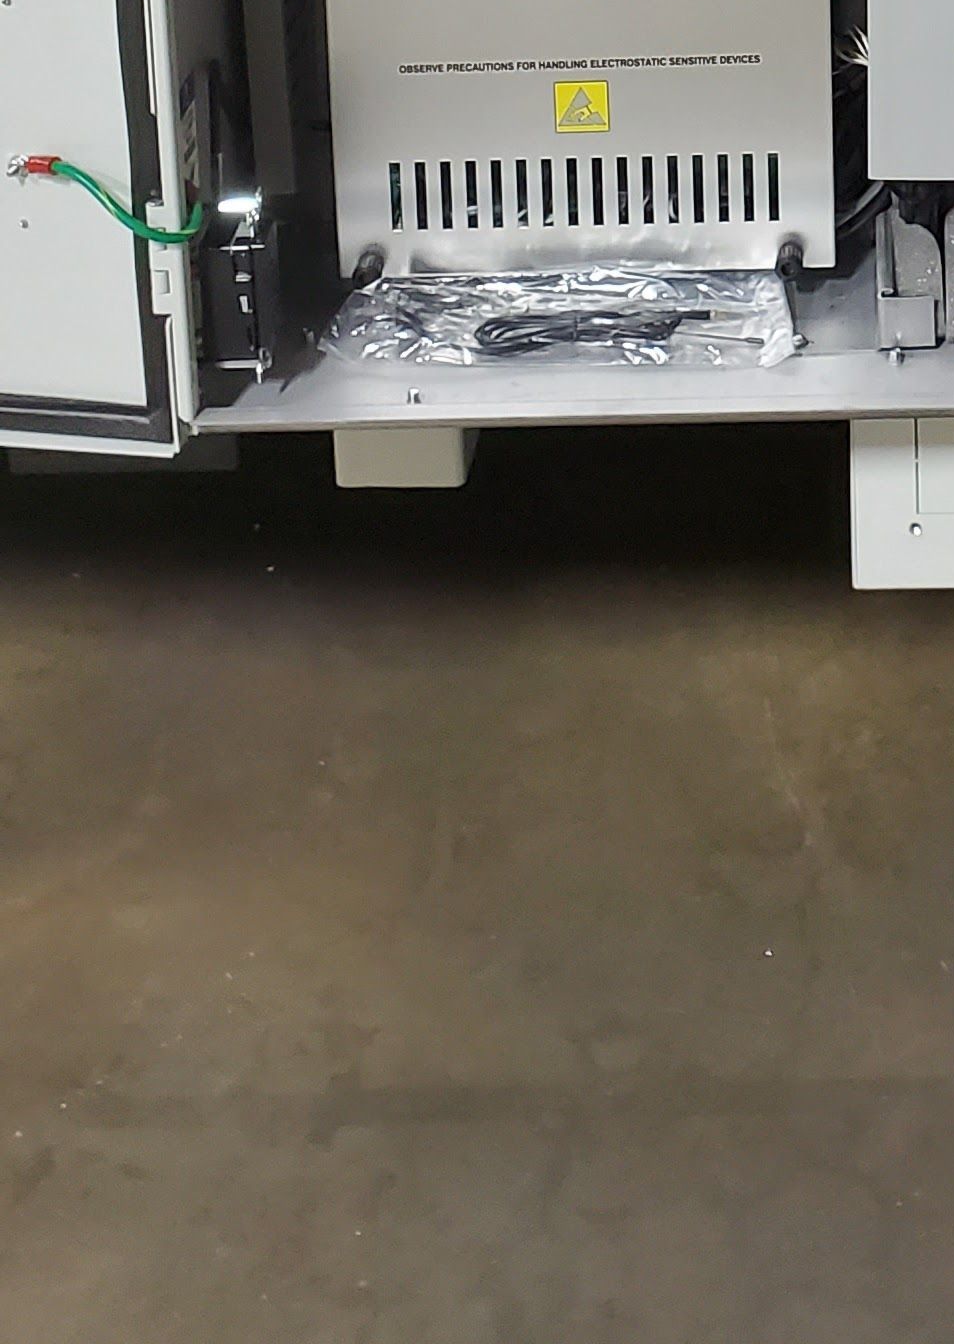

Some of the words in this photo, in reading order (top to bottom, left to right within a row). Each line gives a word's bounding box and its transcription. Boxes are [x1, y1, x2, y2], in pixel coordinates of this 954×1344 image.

[398, 64, 445, 74] OBSERVE
[446, 62, 515, 73] PRECAUTIONS
[516, 61, 537, 71] FOR
[538, 59, 588, 71] HANDLING
[590, 57, 667, 69] ELECTROSTATIC
[668, 55, 718, 66] SENSITIVE
[719, 54, 761, 65] DEVICES
